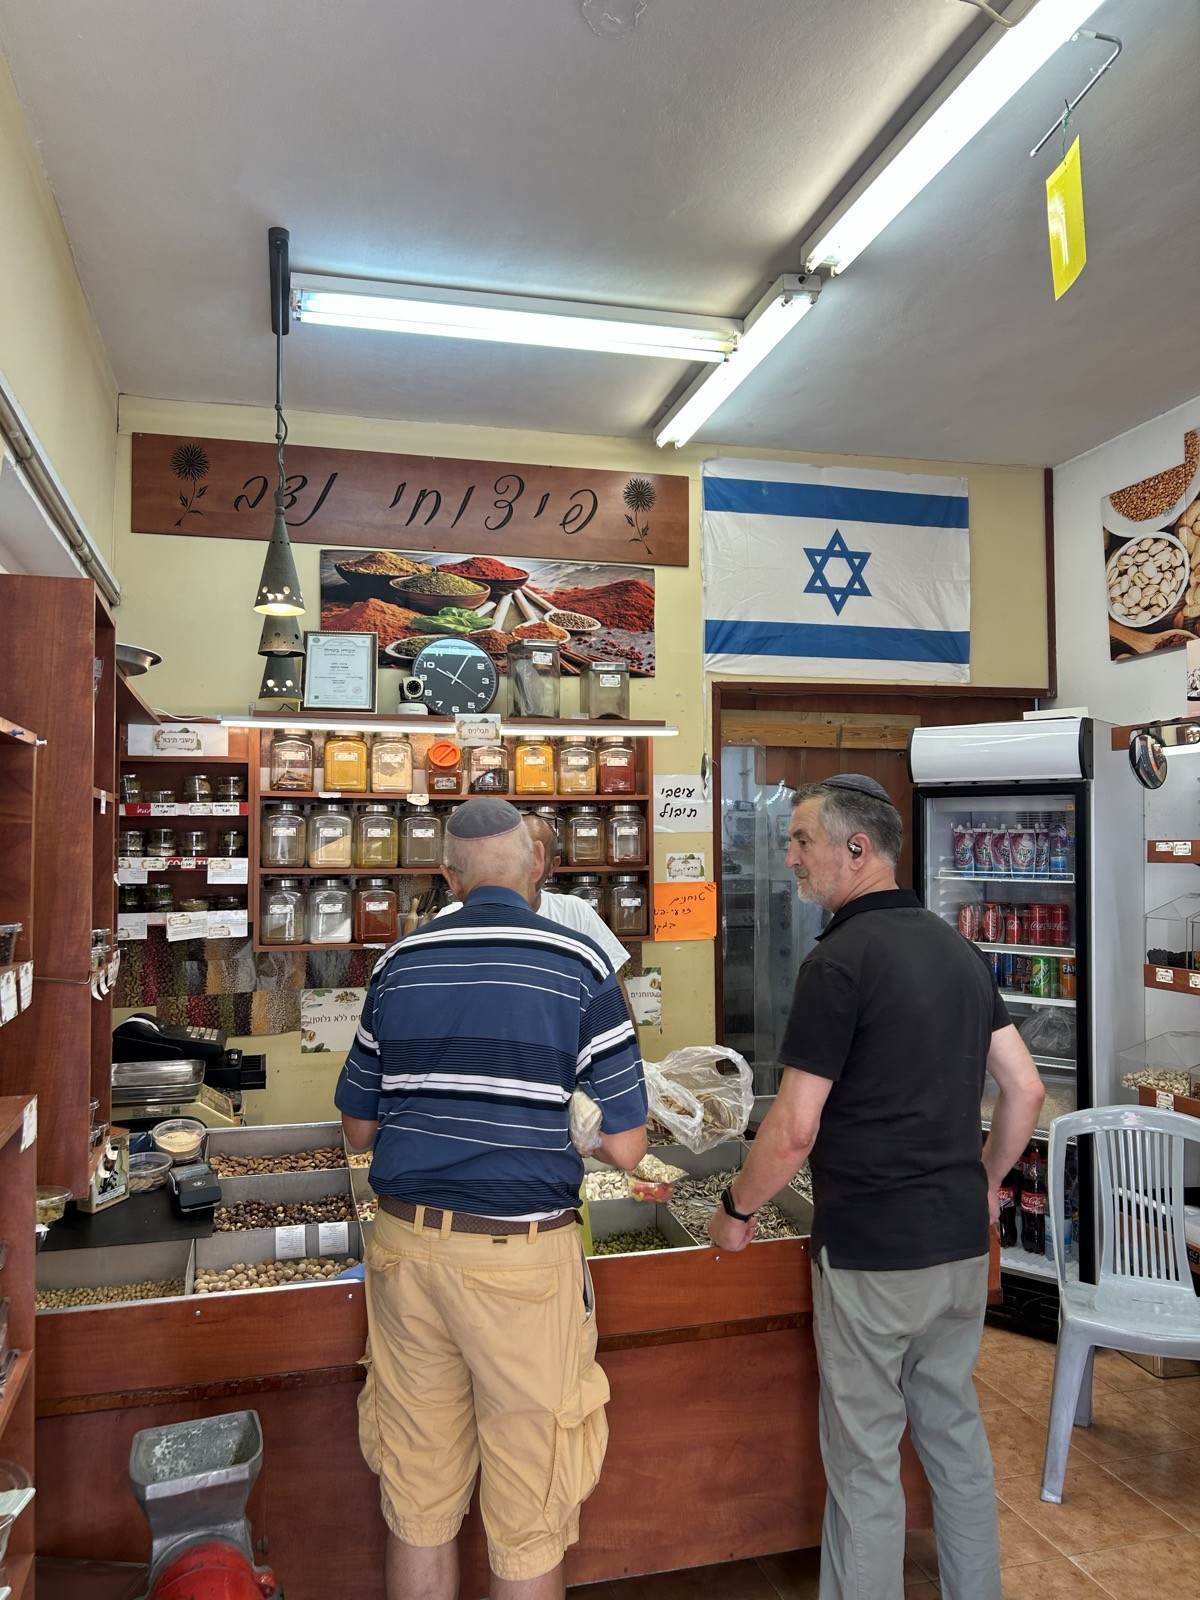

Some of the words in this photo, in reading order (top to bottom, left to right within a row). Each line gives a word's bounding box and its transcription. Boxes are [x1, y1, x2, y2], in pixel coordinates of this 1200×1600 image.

[389, 474, 598, 534] פיצוחי
[660, 802, 698, 818] תיבול
[334, 1014, 348, 1022] ללא
